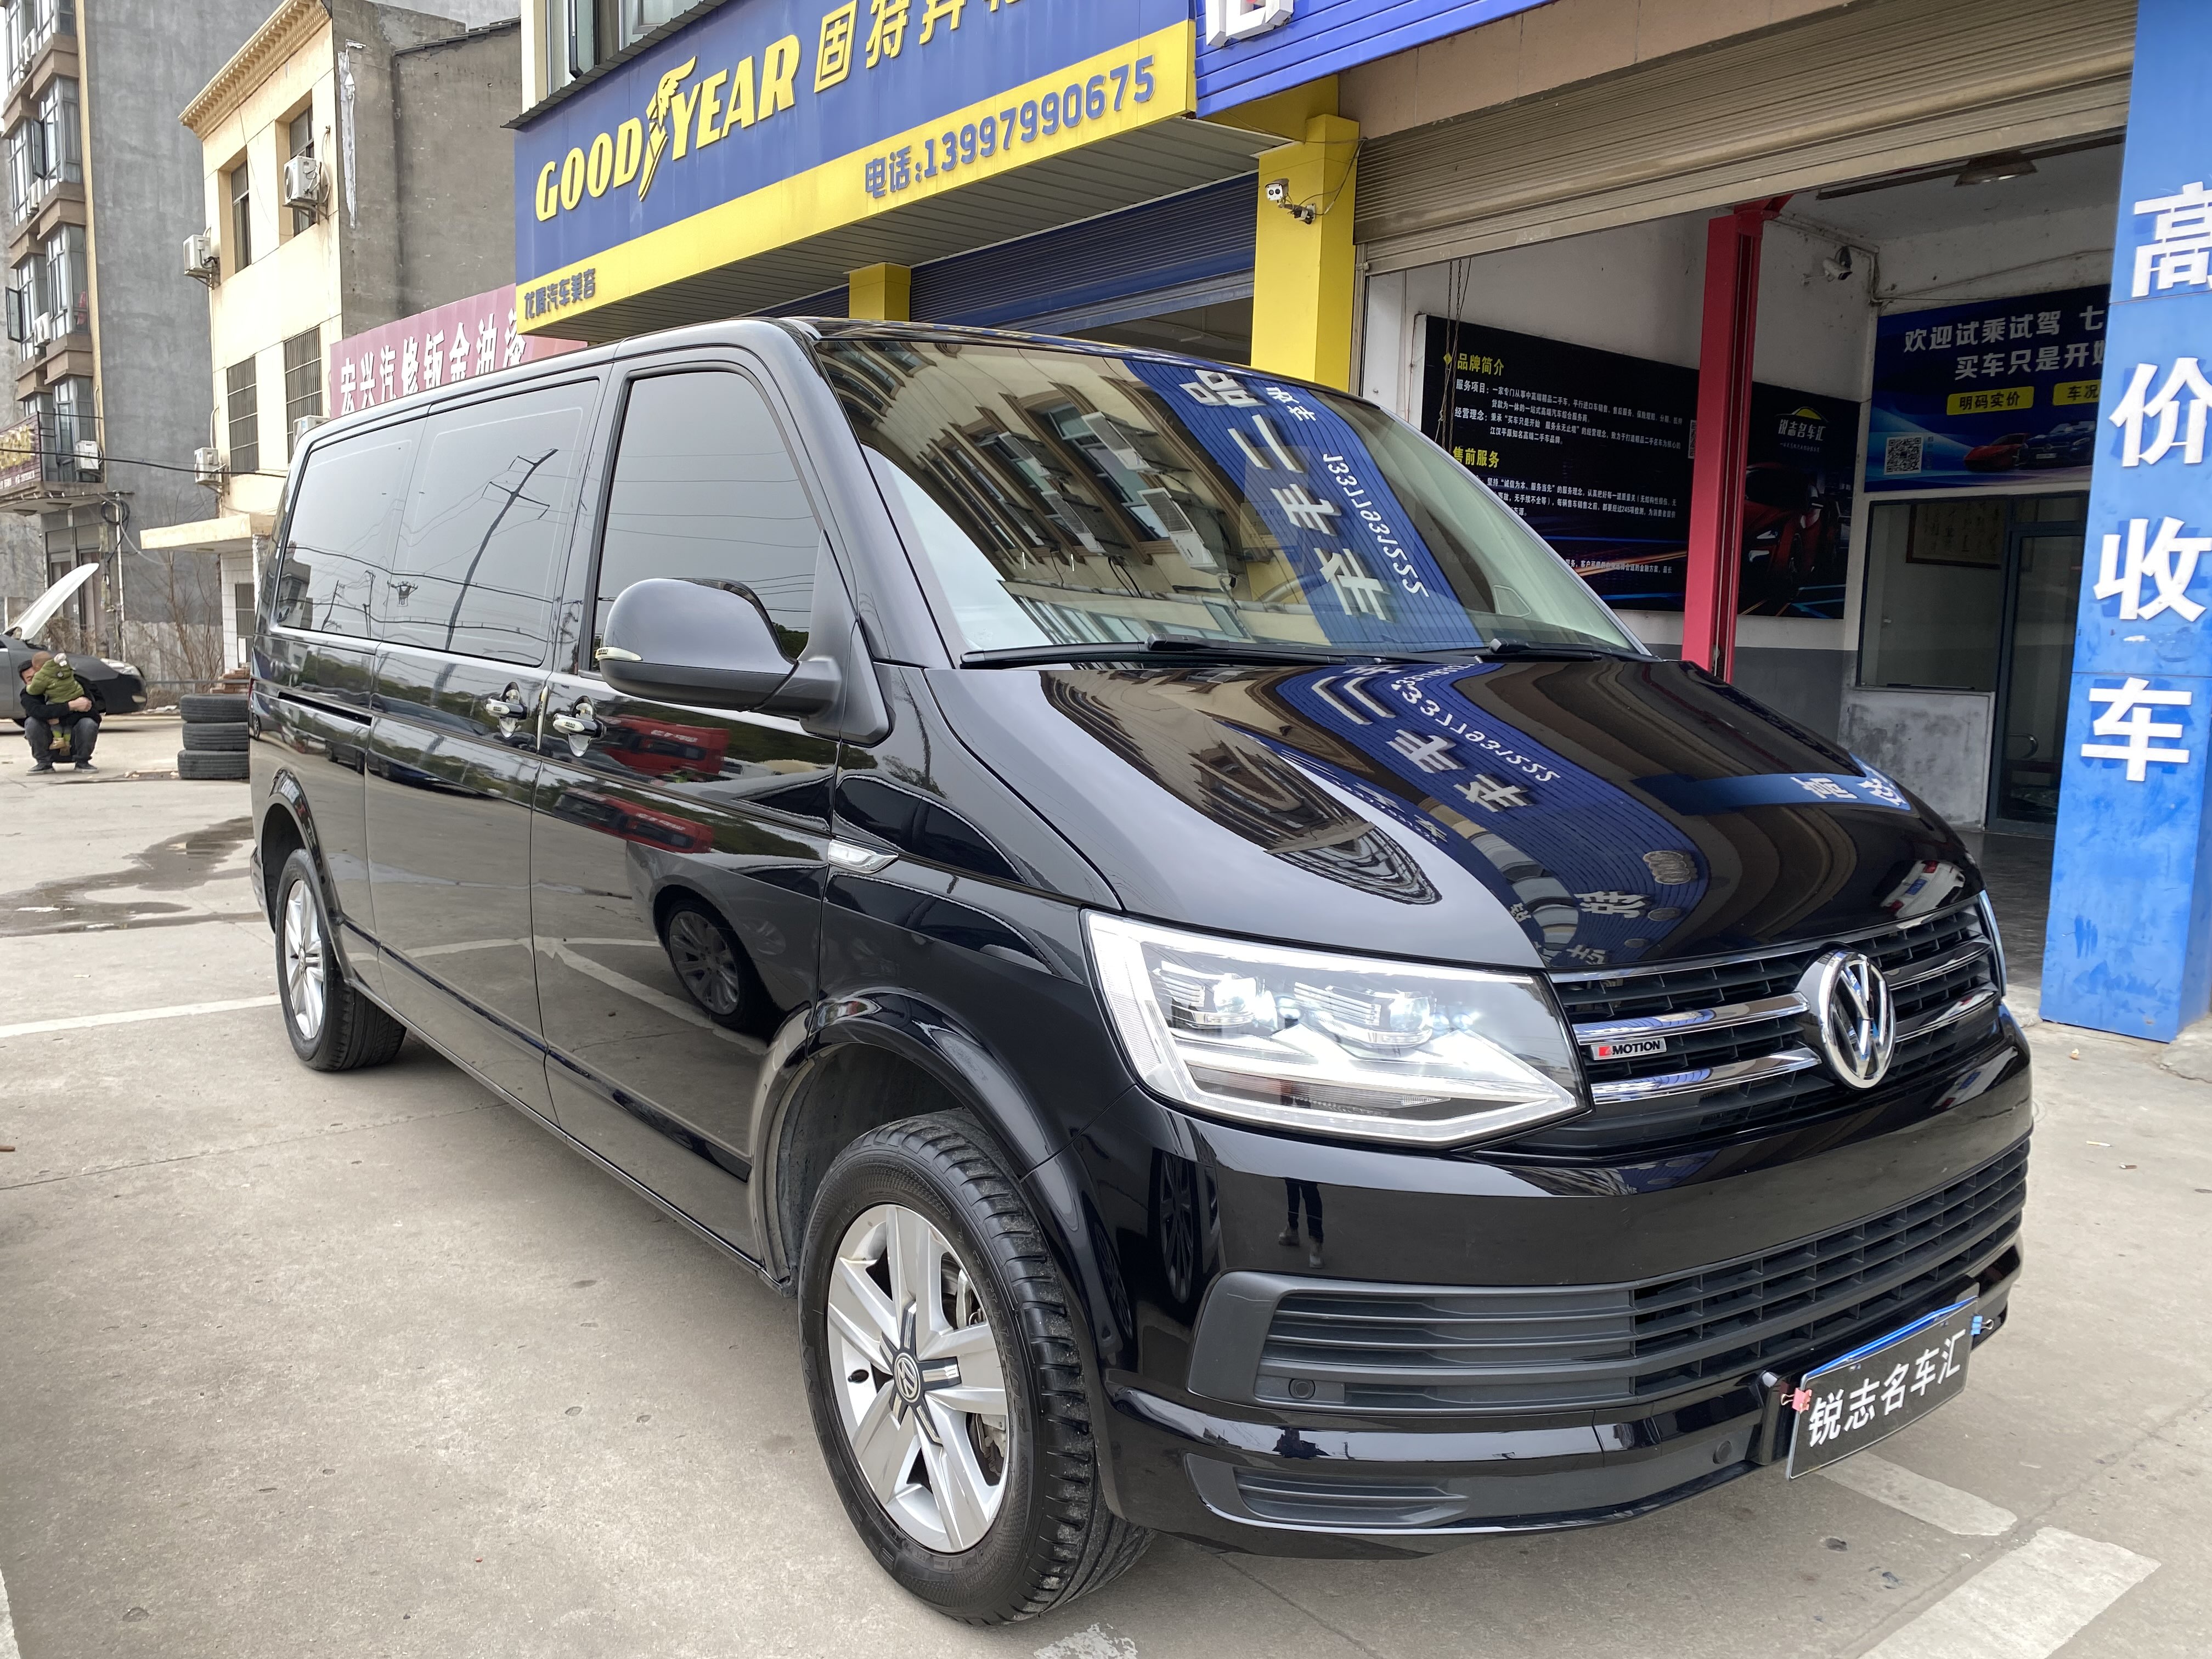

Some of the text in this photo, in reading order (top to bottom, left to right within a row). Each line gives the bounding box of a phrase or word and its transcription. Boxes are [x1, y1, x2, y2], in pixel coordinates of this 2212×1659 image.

[814, 0, 1022, 93] 固特
[535, 33, 802, 222] GOODYEAR
[1904, 311, 2062, 353] 欢迎试乘试驾
[1457, 353, 1504, 376] 品牌简介
[1959, 384, 2099, 410] 明码实价 车况
[1453, 446, 1500, 468] 售前服务
[1809, 1329, 1966, 1447] 锐志名车汇
